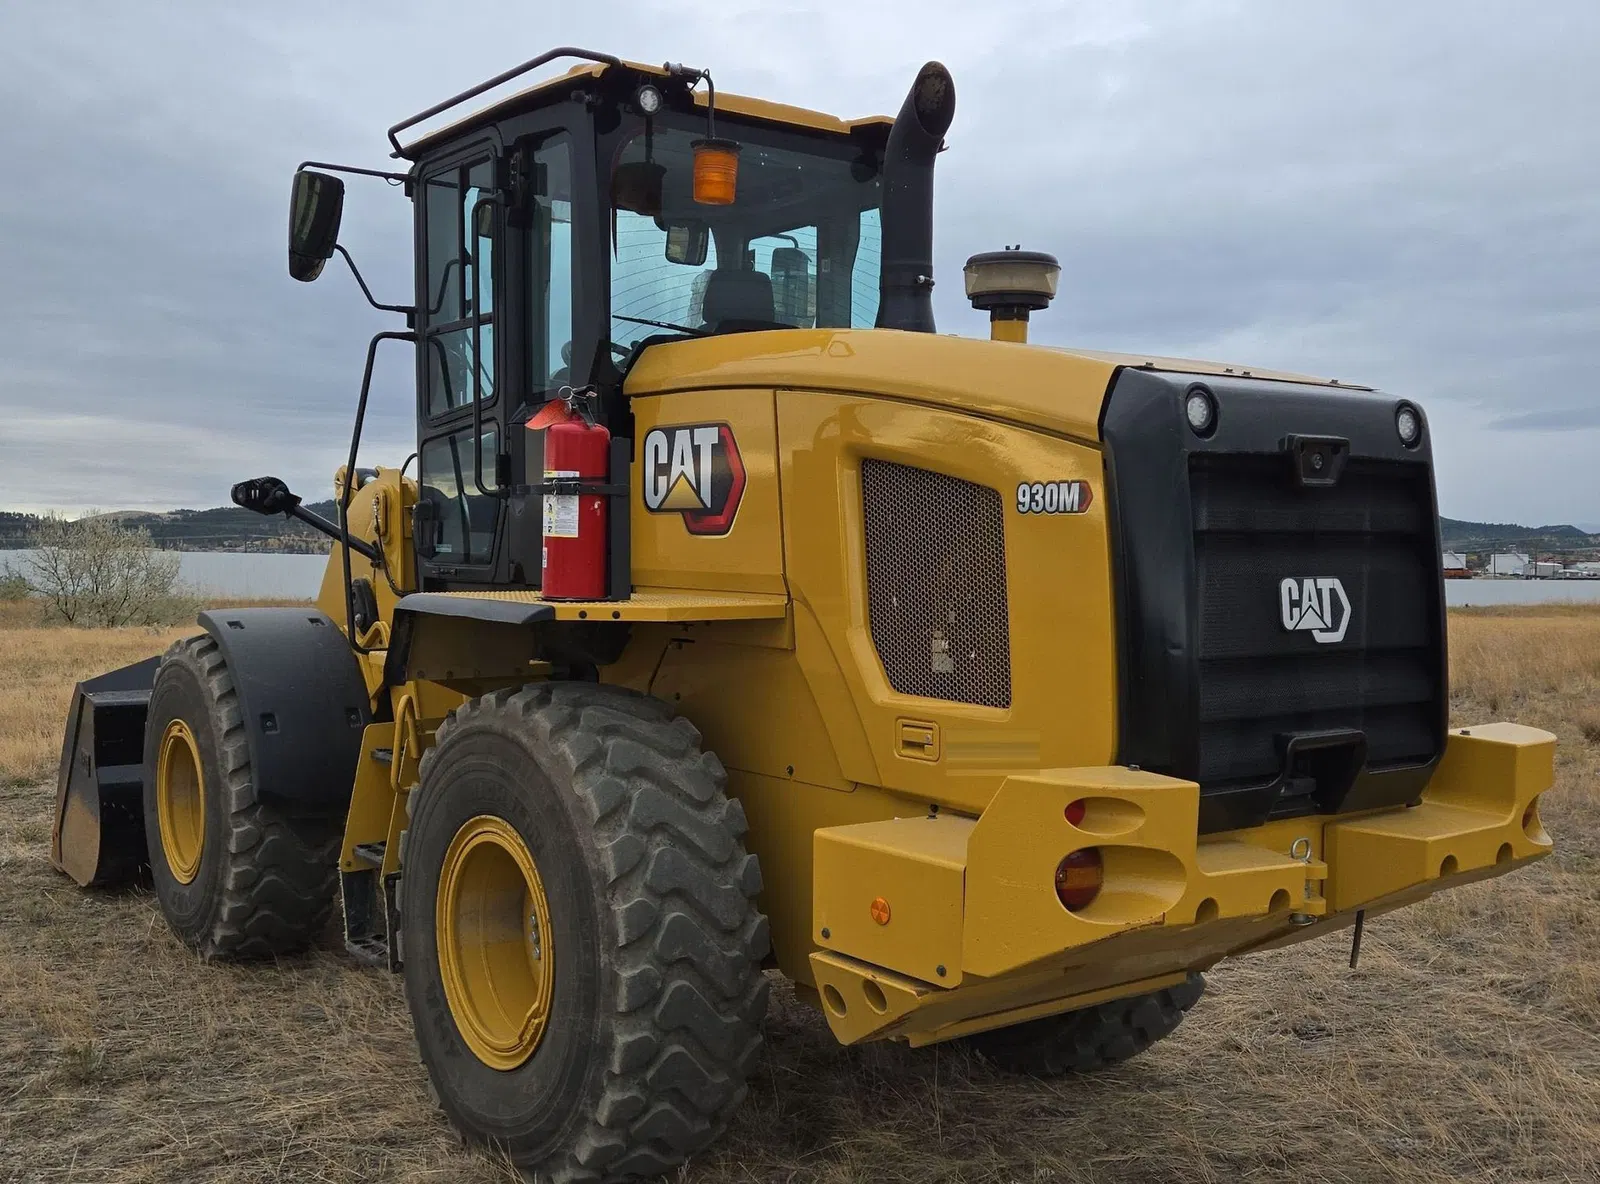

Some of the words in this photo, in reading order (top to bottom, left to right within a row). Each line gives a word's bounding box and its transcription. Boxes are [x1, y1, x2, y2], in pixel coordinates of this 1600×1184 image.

[645, 427, 718, 509] CAT
[1017, 482, 1080, 512] 930M
[1281, 578, 1334, 630] CAT
